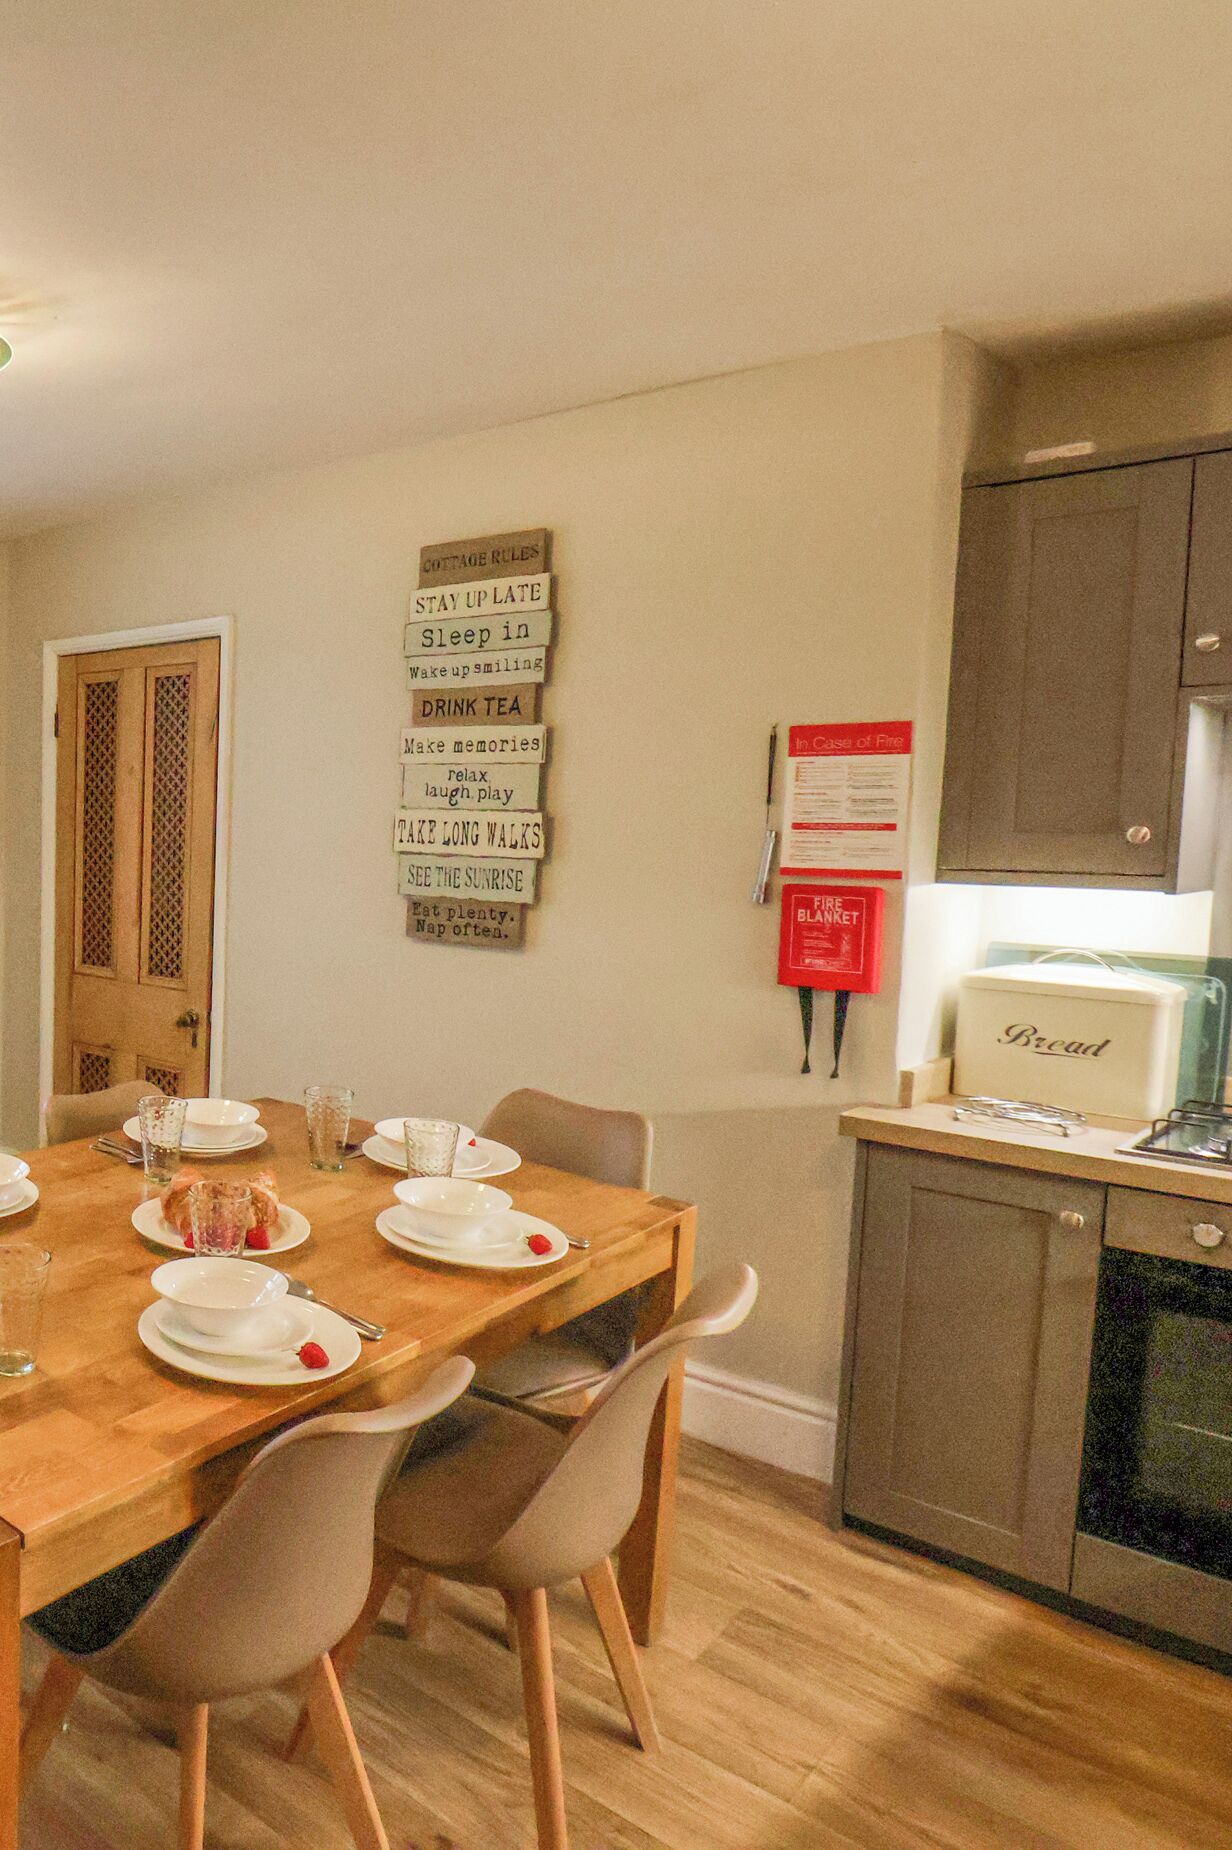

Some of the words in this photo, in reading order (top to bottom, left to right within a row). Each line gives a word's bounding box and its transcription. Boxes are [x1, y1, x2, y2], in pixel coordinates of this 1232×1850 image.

[423, 555, 487, 573] COTTAGE
[491, 544, 539, 564] RULES
[415, 592, 460, 614] STAY
[466, 590, 487, 608] UP
[493, 582, 541, 604] LATE
[421, 626, 491, 648] Sleep
[502, 620, 529, 640] in
[409, 665, 448, 680] Wake
[452, 665, 470, 679] up
[473, 656, 543, 675] smiling
[421, 697, 477, 718] DRINK
[483, 695, 521, 716] TEA
[404, 737, 445, 755] Make
[453, 735, 540, 753] memories
[795, 737, 809, 751] In
[812, 736, 853, 751] Case
[856, 735, 872, 747] of
[875, 734, 905, 749] Fire
[477, 784, 514, 806] play
[398, 818, 436, 845] TAKE
[441, 820, 479, 847] LONG
[487, 821, 541, 850] WALKS
[407, 864, 431, 888] SEE
[435, 865, 461, 889] THE
[464, 866, 524, 893] SUNRISE
[411, 902, 440, 918] Eat
[447, 904, 515, 925] plenty.
[814, 896, 844, 912] FIRE
[797, 908, 860, 925] BLANKET
[415, 918, 446, 938] Nap
[453, 922, 509, 940] often.
[996, 1023, 1113, 1058] Bread
